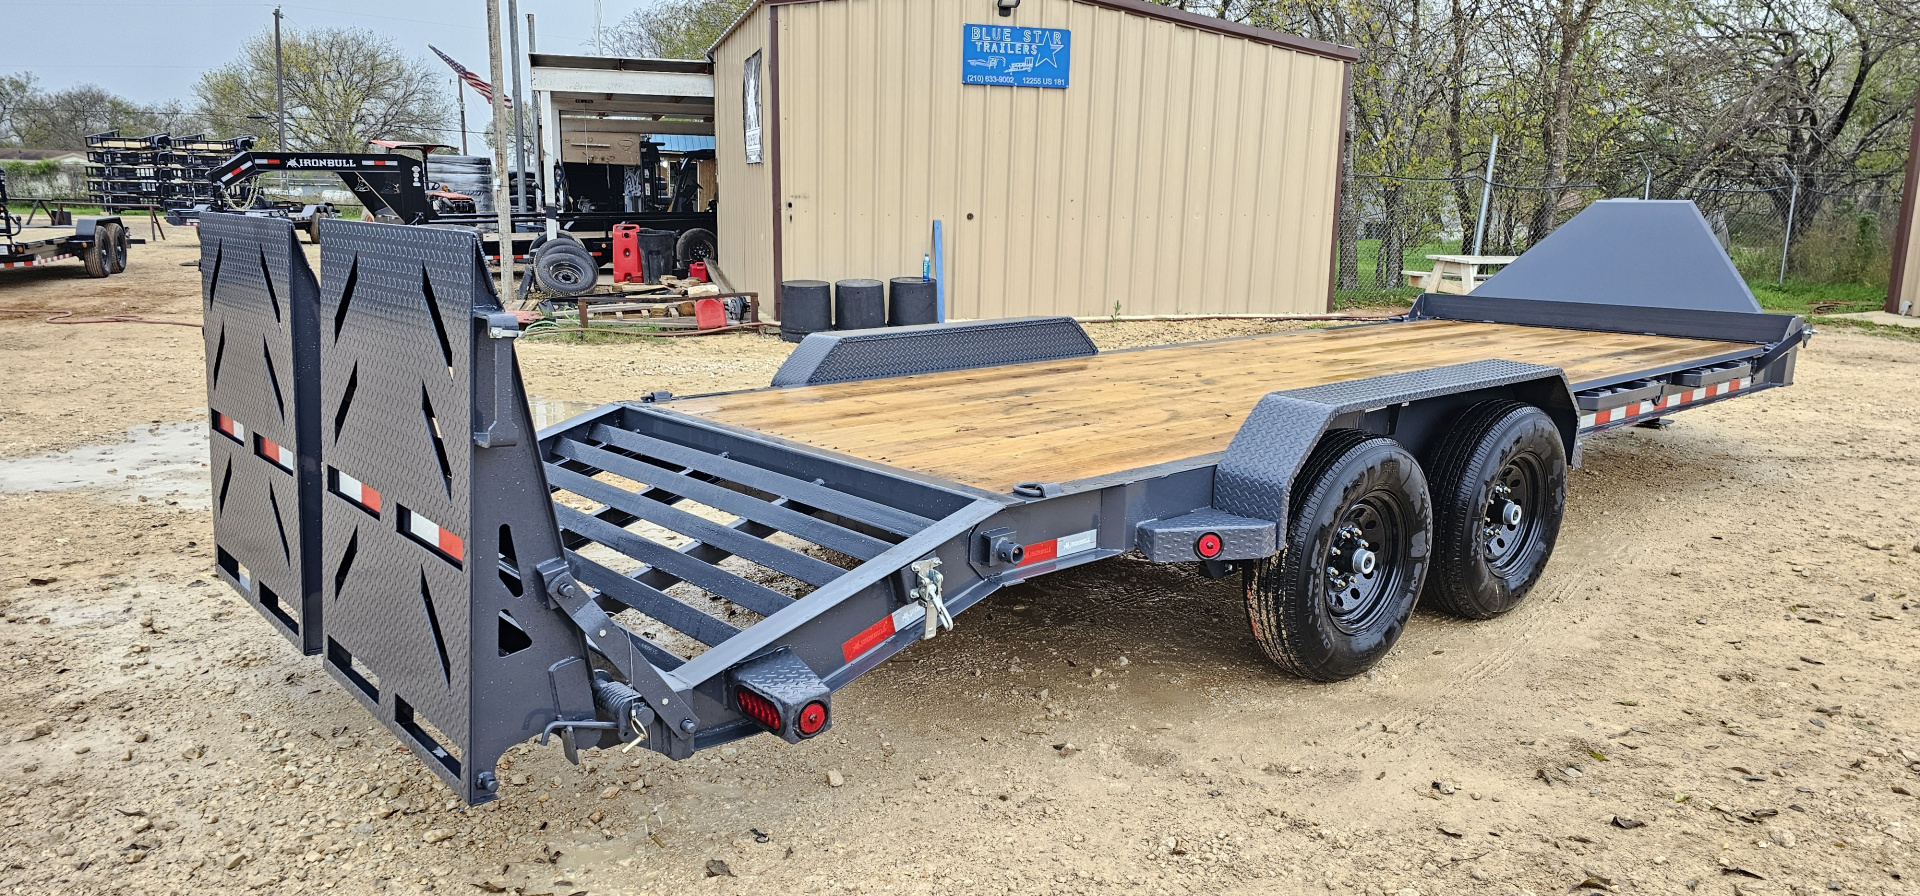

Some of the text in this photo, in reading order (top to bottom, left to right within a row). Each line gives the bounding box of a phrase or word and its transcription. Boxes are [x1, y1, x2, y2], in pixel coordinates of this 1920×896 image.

[971, 27, 1062, 45] BLUE STAR
[975, 42, 1037, 55] TRAILERS
[967, 75, 983, 83] (210)
[298, 158, 357, 167] IRONBULL
